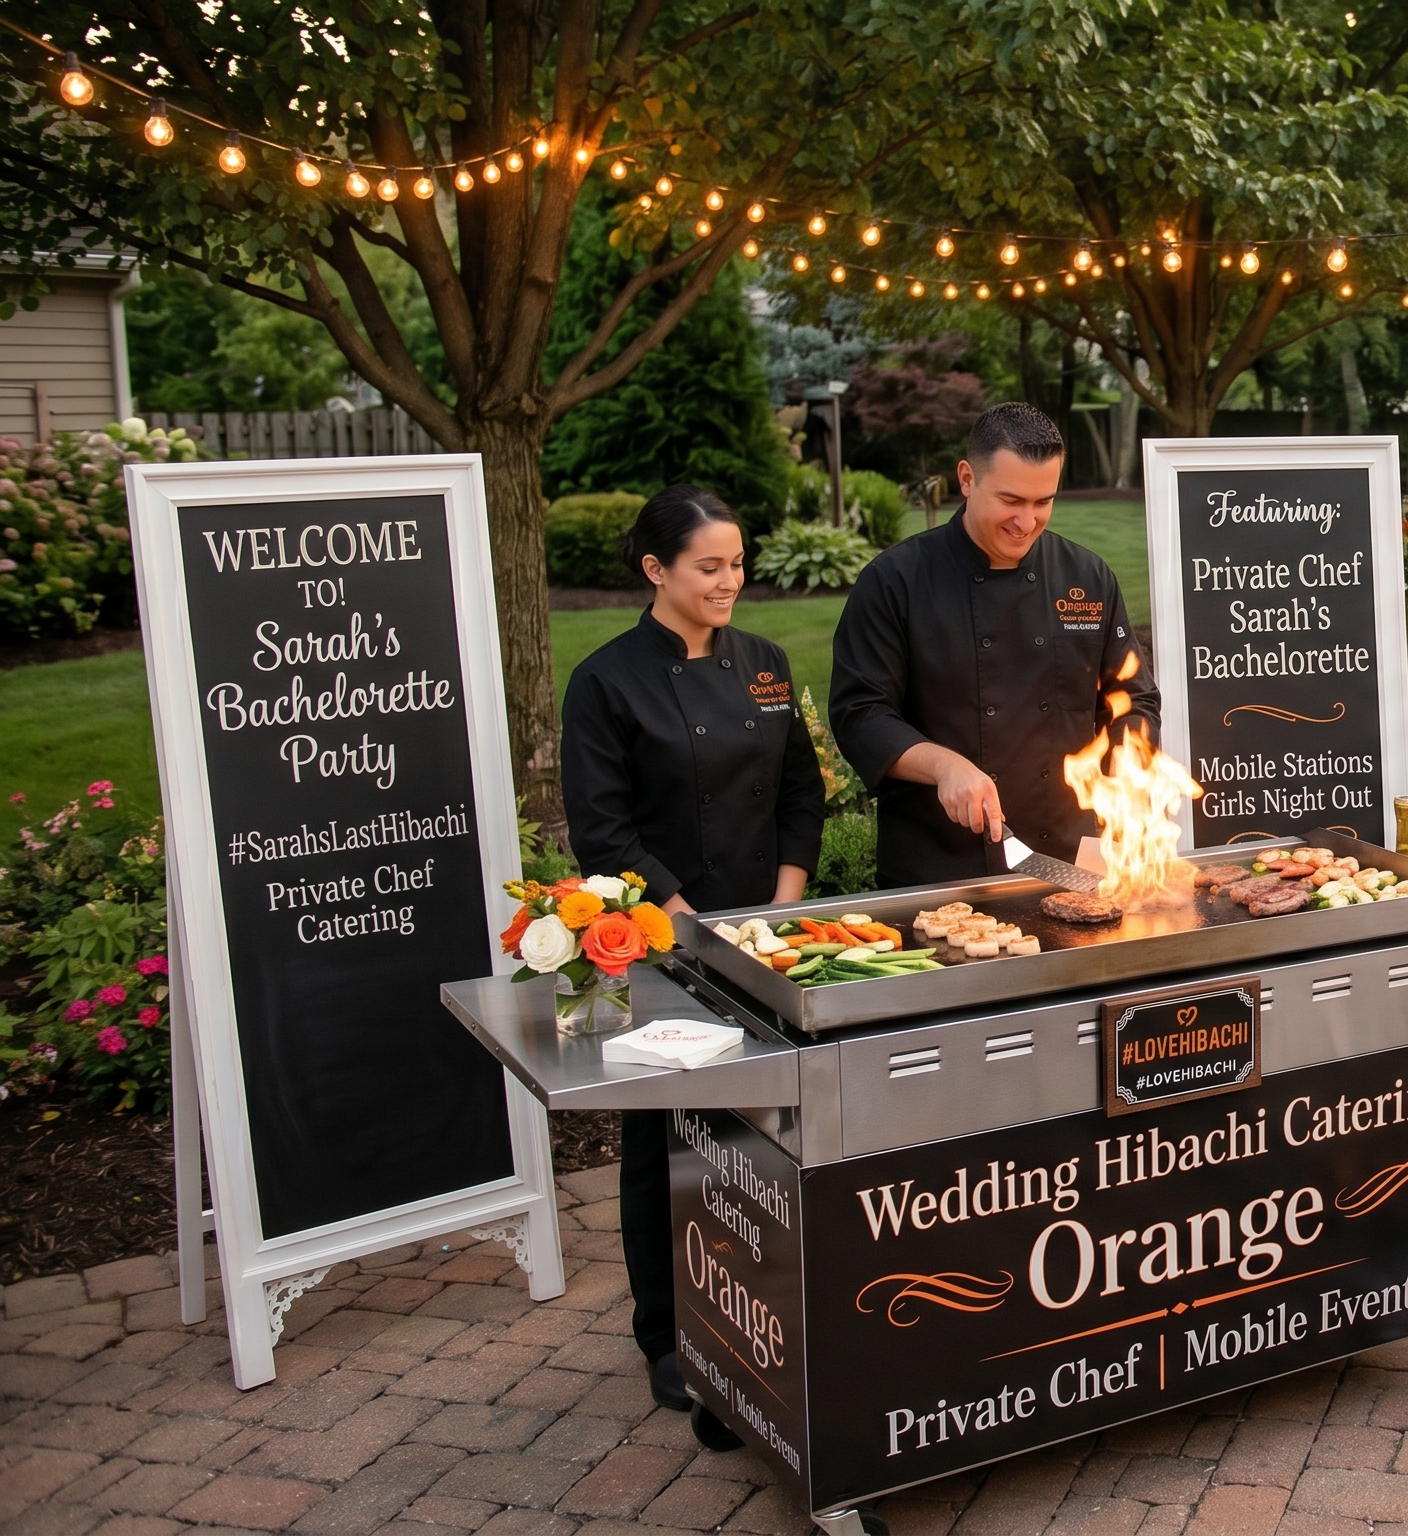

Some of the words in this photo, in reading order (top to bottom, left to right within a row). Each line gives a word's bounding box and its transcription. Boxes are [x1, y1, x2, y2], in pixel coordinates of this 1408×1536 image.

[1207, 489, 1341, 535] Featuring:
[203, 520, 423, 574] WELCOME
[1192, 556, 1291, 592] Private
[1298, 551, 1363, 587] Chef
[298, 578, 347, 610] TO!
[1229, 596, 1331, 634] Sarah's
[253, 612, 401, 673] Sarah's
[1192, 641, 1370, 680] Bachelorette
[206, 670, 456, 732] Bachelorette
[279, 732, 397, 791] Party
[1198, 753, 1277, 783] Mobile
[1283, 748, 1373, 777] Stations
[1201, 792, 1256, 819] Girls
[1263, 786, 1325, 820] Night
[1331, 784, 1373, 810] Out
[228, 803, 470, 866] #SarahsLastHibachi
[266, 872, 366, 912] Private
[373, 858, 435, 895] Chef
[296, 903, 416, 945] Catering
[1122, 1021, 1249, 1067] #LOVEHIBACHI
[1136, 1059, 1236, 1090] #LOVEHIBACHI
[672, 1107, 730, 1188] Wedding
[731, 1146, 791, 1230] Hibachi
[856, 1156, 1081, 1242] Wedding
[1095, 1107, 1270, 1193] Hibachi
[702, 1173, 762, 1263] Catering
[1028, 1184, 1325, 1312] Orange
[686, 1220, 785, 1369] Orange
[885, 1383, 1037, 1458] Private
[1049, 1342, 1144, 1406] Chef
[1184, 1302, 1308, 1374] Mobile
[736, 1387, 769, 1441] Mobile
